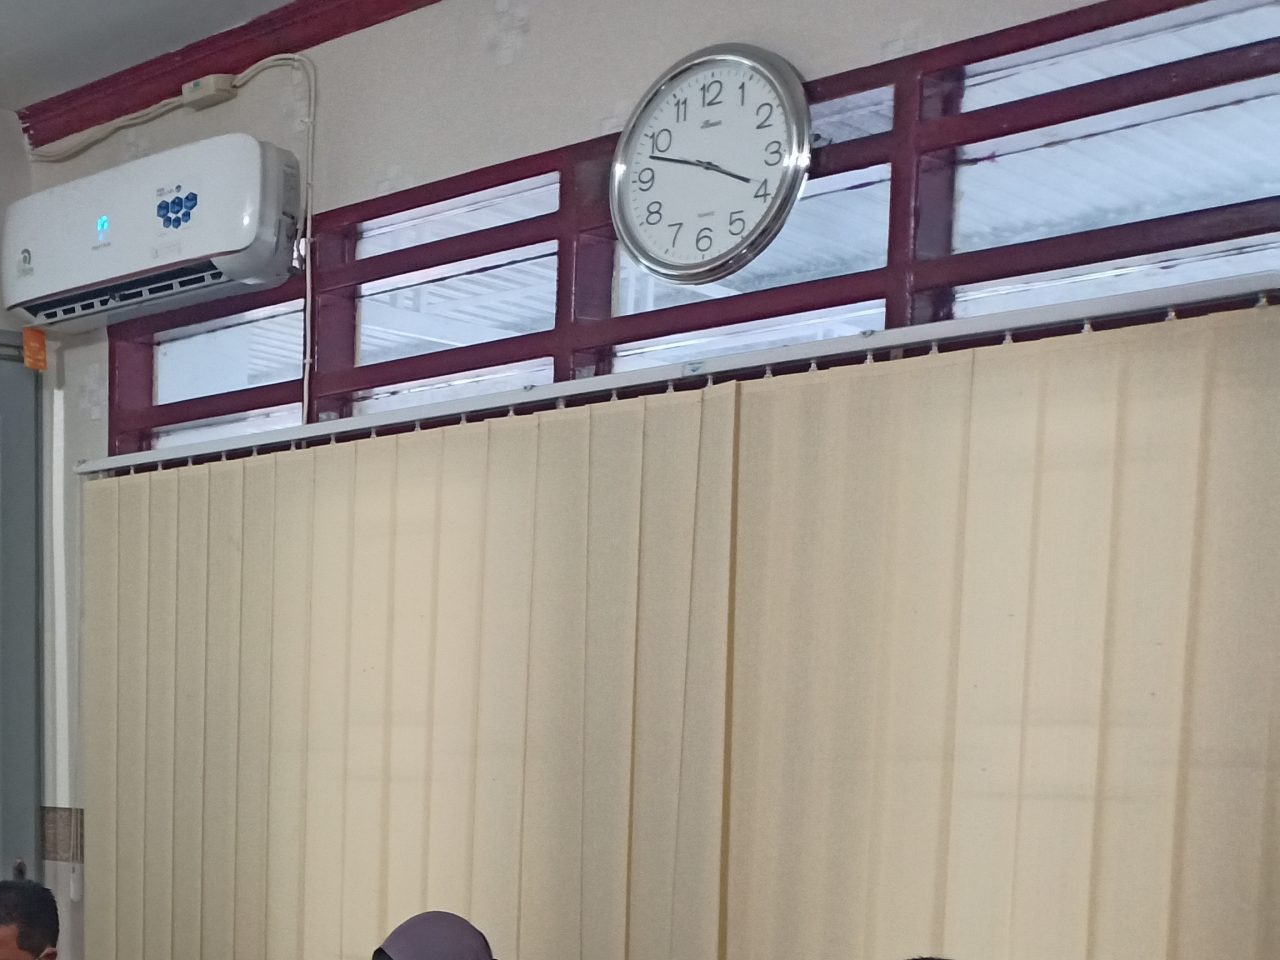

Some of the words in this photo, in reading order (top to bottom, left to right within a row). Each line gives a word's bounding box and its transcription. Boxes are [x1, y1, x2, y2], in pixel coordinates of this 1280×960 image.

[700, 80, 723, 107] 12
[738, 82, 745, 106] 1
[674, 97, 688, 123] 11
[756, 103, 773, 129] 2
[648, 129, 672, 154] 10
[764, 141, 782, 166] 3
[638, 167, 655, 191] 9
[754, 179, 771, 203] 4
[646, 201, 662, 225] 8
[729, 210, 745, 235] 5
[668, 223, 683, 248] 7
[696, 227, 714, 251] 6
